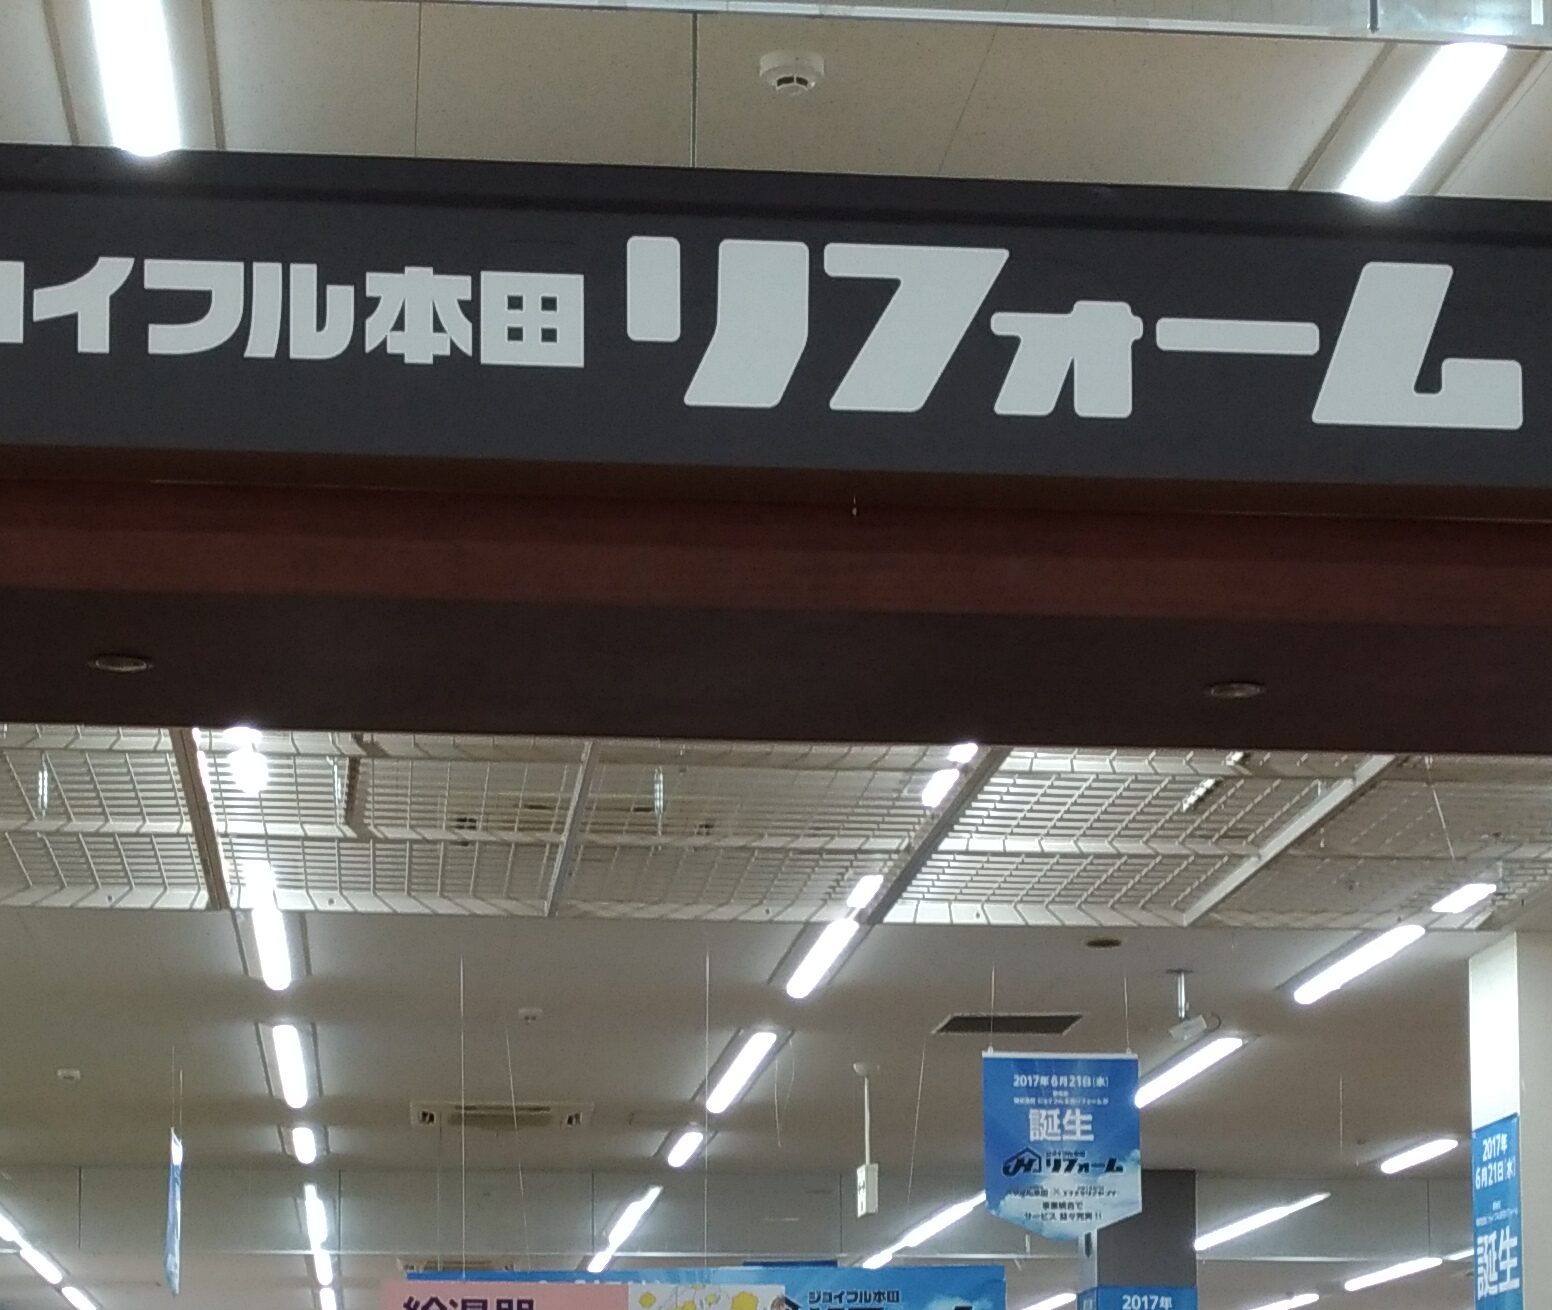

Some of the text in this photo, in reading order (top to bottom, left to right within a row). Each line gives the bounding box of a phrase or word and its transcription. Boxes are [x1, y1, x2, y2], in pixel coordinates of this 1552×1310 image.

[626, 236, 1524, 429] リフォーム
[1028, 1107, 1095, 1142] 誕生
[1482, 1133, 1508, 1163] 2017年
[1045, 1157, 1124, 1174] リフォーム
[1476, 1231, 1521, 1299] 誕生
[808, 1290, 901, 1304] ジョイフル本田
[1122, 1294, 1173, 1310] 2017年
